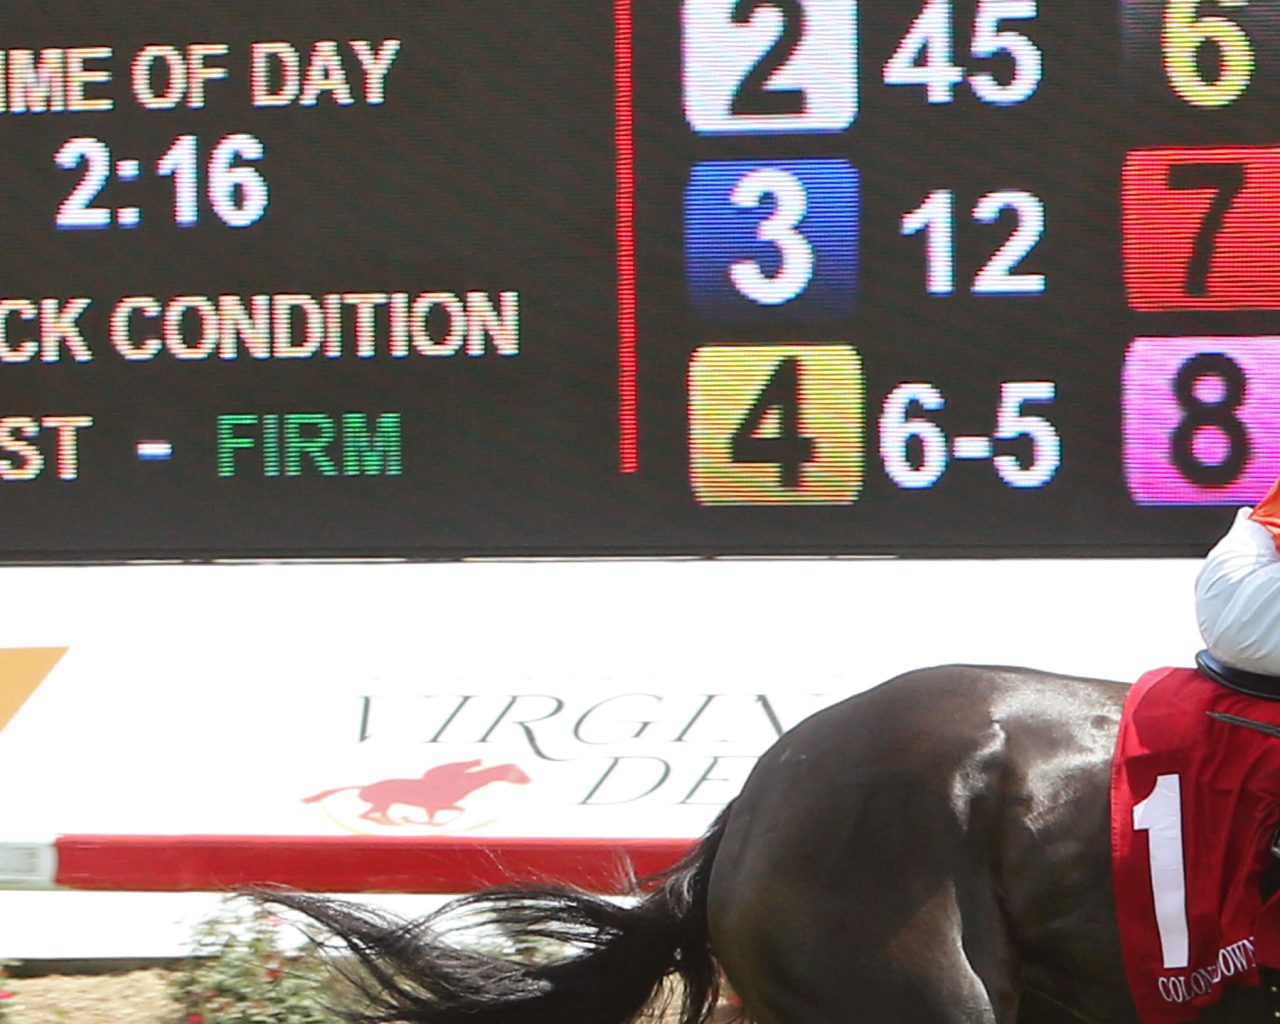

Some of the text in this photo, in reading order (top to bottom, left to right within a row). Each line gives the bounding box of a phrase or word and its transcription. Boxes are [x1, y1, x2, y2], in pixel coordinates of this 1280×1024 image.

[130, 43, 230, 109] OF
[250, 38, 401, 107] DAY
[728, 0, 808, 116] 2
[881, 0, 1044, 106] 45
[1161, 0, 1256, 108] 6
[54, 133, 270, 229] 2:16
[1166, 162, 1247, 297] 7
[729, 167, 815, 305] 3
[899, 189, 1046, 296] 12
[0, 291, 520, 363] CK CONDITION
[216, 412, 402, 477] FIRM
[730, 355, 817, 489] 4
[878, 381, 1062, 489] 6-5
[1170, 352, 1251, 488] 8
[1132, 773, 1189, 969] 1
